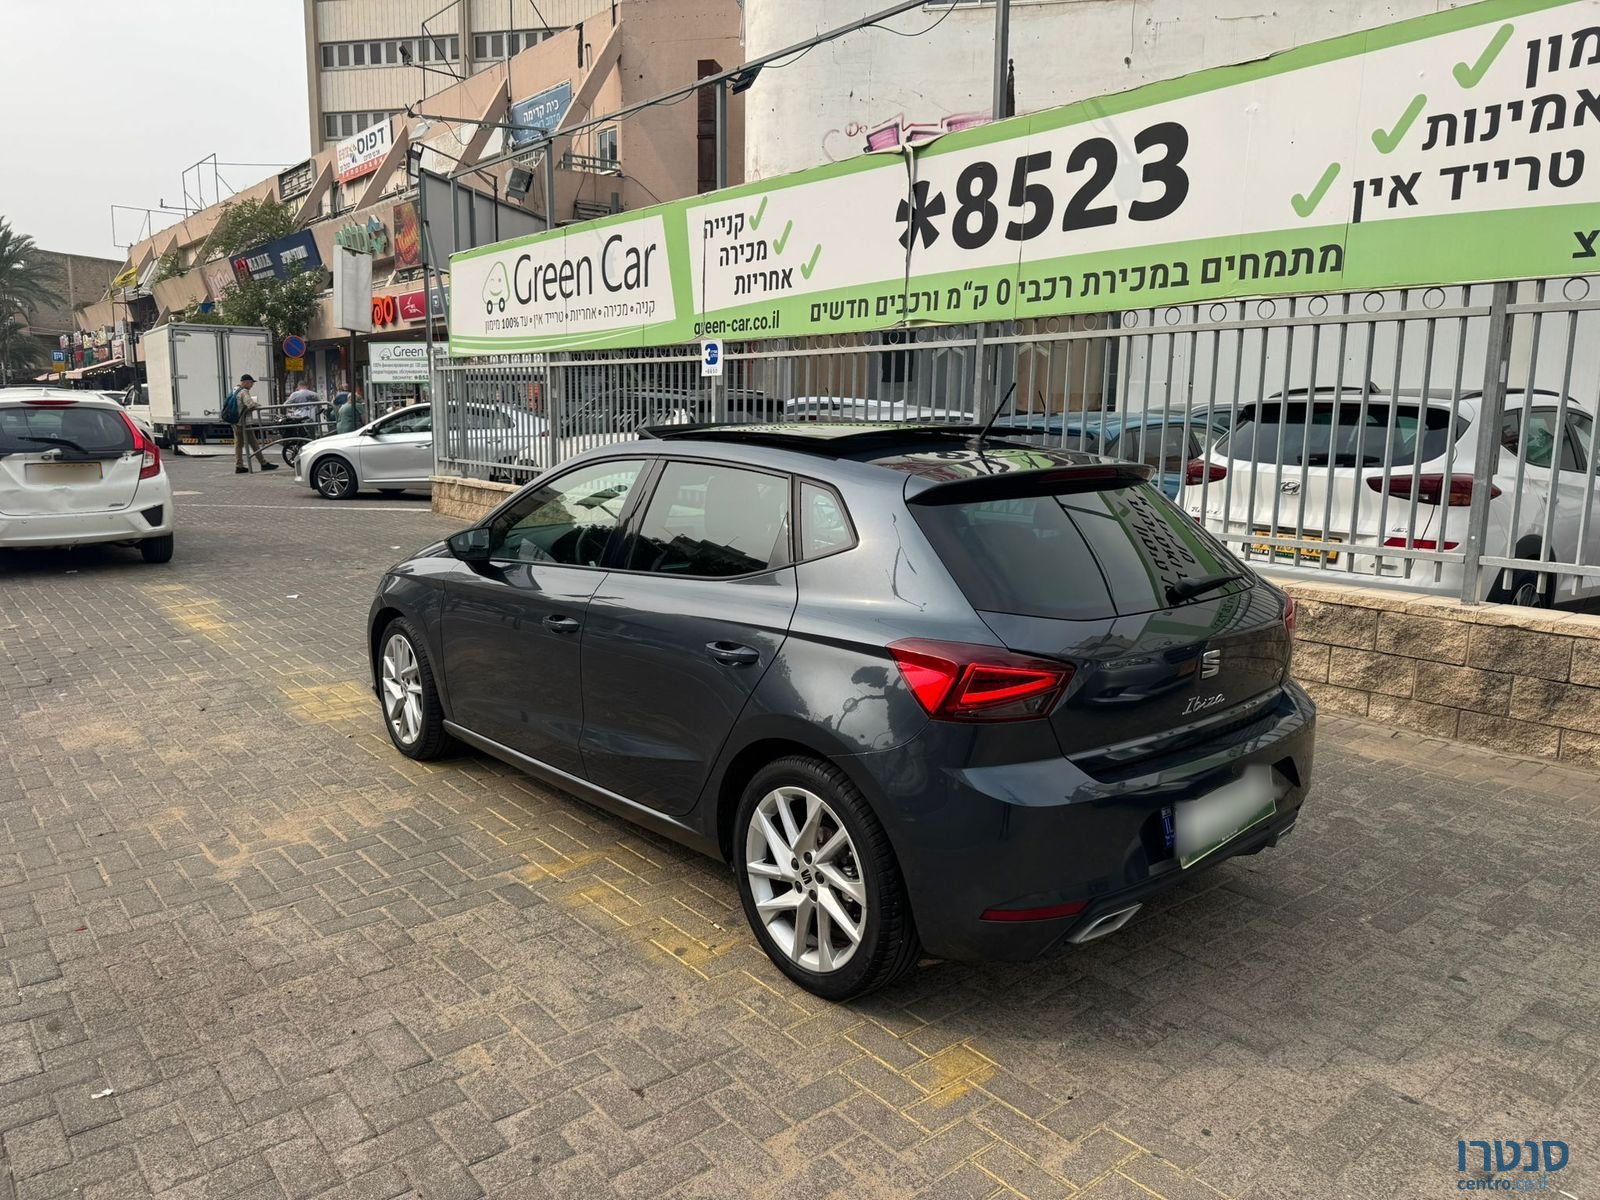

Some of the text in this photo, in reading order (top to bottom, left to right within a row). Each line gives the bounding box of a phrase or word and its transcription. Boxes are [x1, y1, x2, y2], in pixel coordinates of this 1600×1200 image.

[1421, 88, 1600, 151] אמינות
[357, 127, 384, 155] דפוס
[1352, 149, 1585, 224] טרייד אין
[703, 212, 744, 240] קנייה
[719, 239, 767, 267] מכירה
[1201, 243, 1343, 284] מתמחים
[514, 234, 656, 305] Green Car
[734, 267, 793, 295] אחריות
[1080, 262, 1189, 298] במכירת
[996, 278, 1011, 305] 0
[1018, 275, 1073, 303] רכבי
[570, 307, 597, 322] אחריות
[603, 303, 628, 318] מכירה
[635, 300, 655, 317] קניה
[810, 298, 869, 322] חדשים
[501, 317, 519, 330] 100%
[393, 345, 424, 357] Green
[1181, 692, 1225, 716] Ibiza
